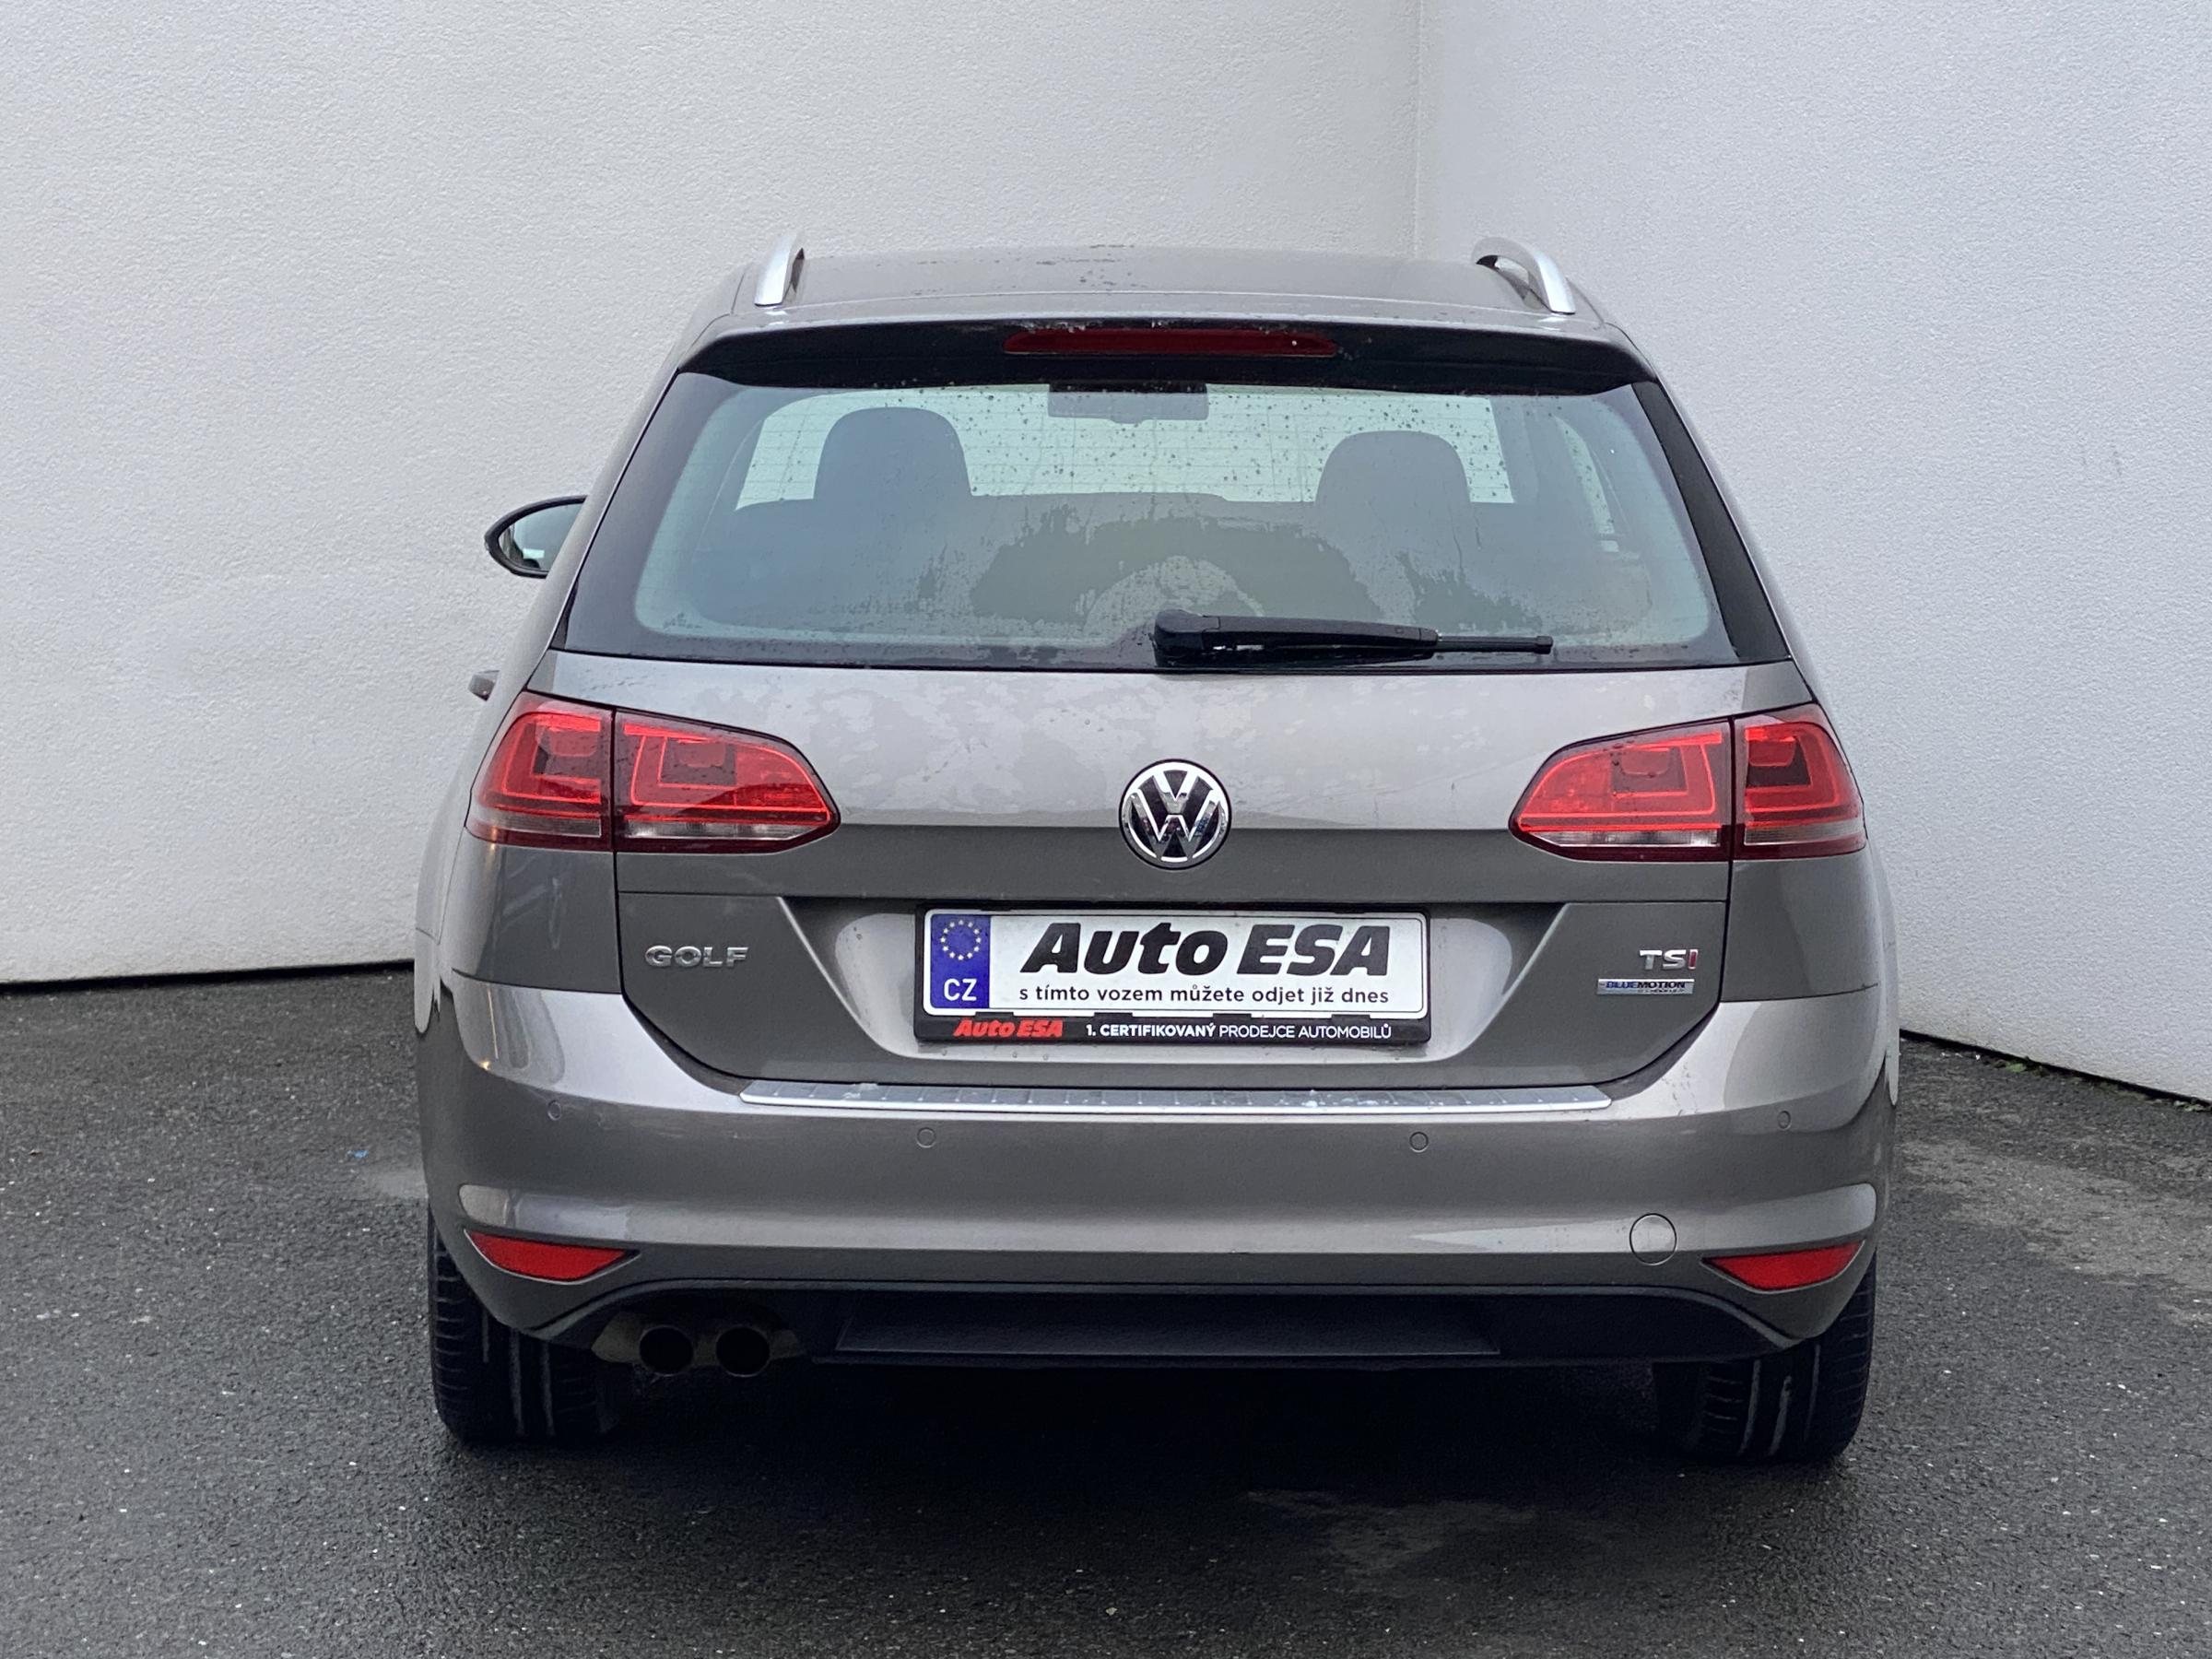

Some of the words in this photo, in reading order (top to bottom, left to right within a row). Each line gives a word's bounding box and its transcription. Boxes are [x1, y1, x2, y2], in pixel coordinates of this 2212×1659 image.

[645, 945, 749, 968] GOLF
[1020, 922, 1229, 976] Auto
[1237, 924, 1391, 977] ESA
[1639, 948, 1699, 971] TSI
[943, 978, 978, 1002] CZ
[1019, 987, 1029, 1001] s
[1036, 984, 1090, 1001] tímto
[1097, 988, 1163, 1002] vozem
[1170, 983, 1245, 1003] můžete
[1252, 986, 1305, 1006] odjet
[1310, 986, 1335, 1006] již
[1341, 988, 1389, 1004] dnes
[1605, 981, 1686, 989] BLUEMOTION
[953, 1019, 1016, 1038] Auto
[1016, 1019, 1064, 1038] ESA
[1086, 1024, 1097, 1037] 1.
[1100, 1022, 1217, 1038] CERTIFIKOVANÝ
[1218, 1024, 1296, 1039] PRODEJCE
[1298, 1023, 1392, 1040] AUTOMOBILŮ
